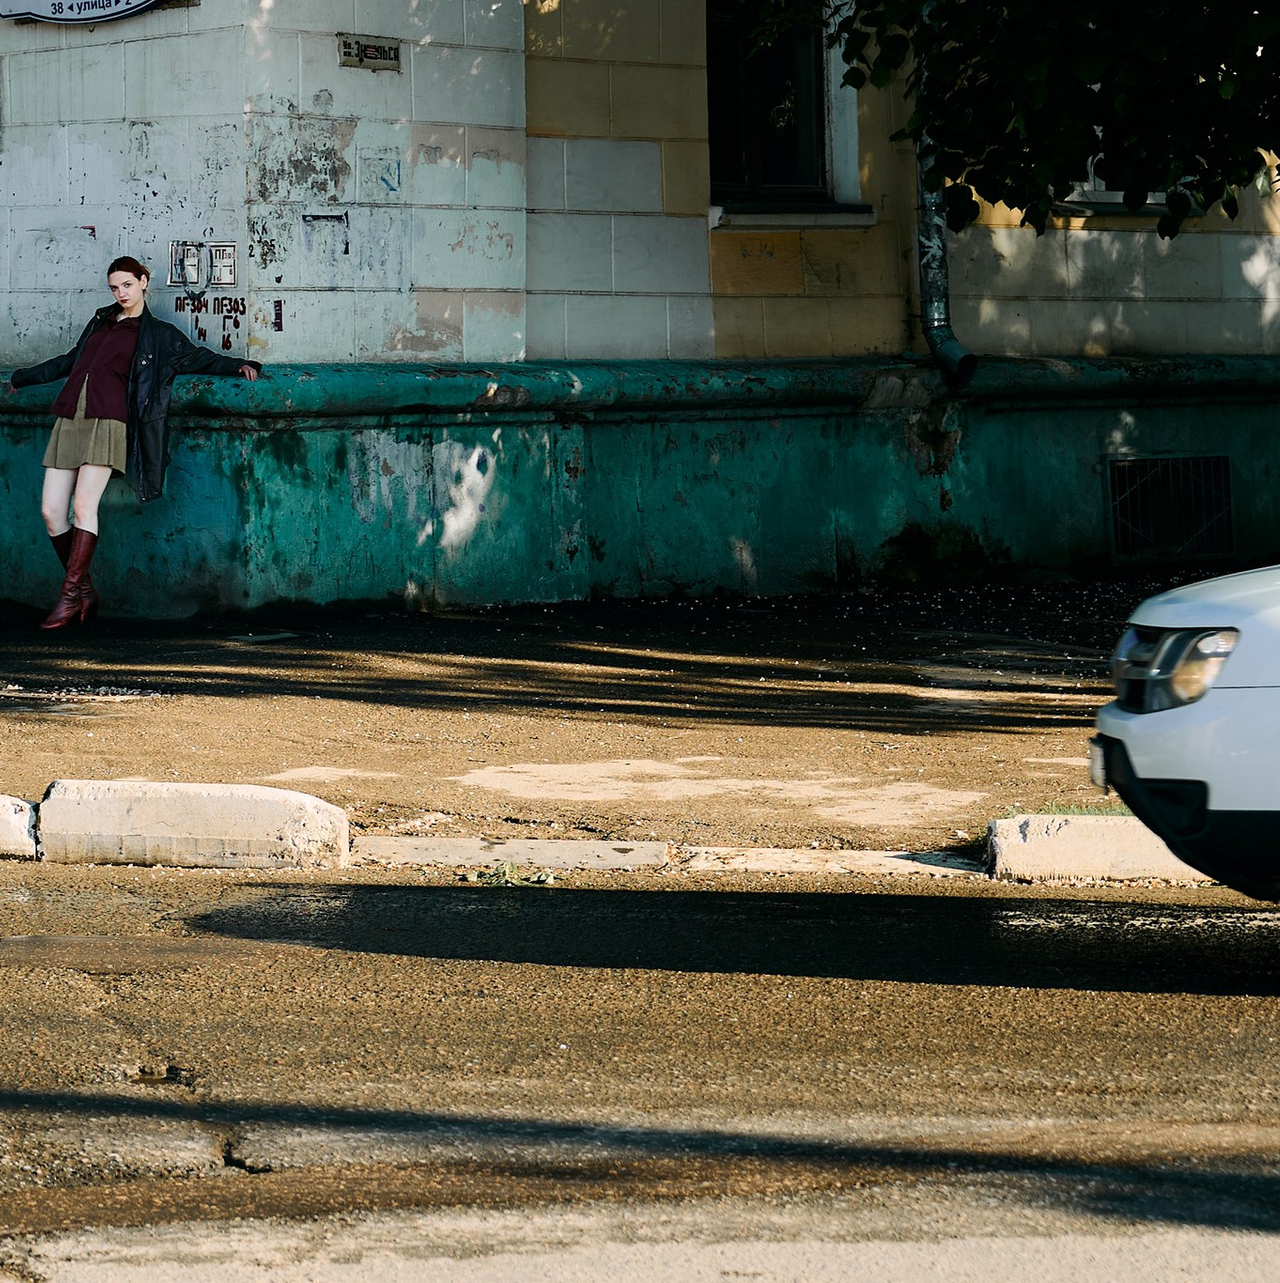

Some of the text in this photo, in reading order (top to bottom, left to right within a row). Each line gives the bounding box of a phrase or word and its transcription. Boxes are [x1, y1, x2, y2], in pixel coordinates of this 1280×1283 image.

[51, 2, 64, 15] 38
[175, 296, 246, 315] ПГ-304 ПГ-303
